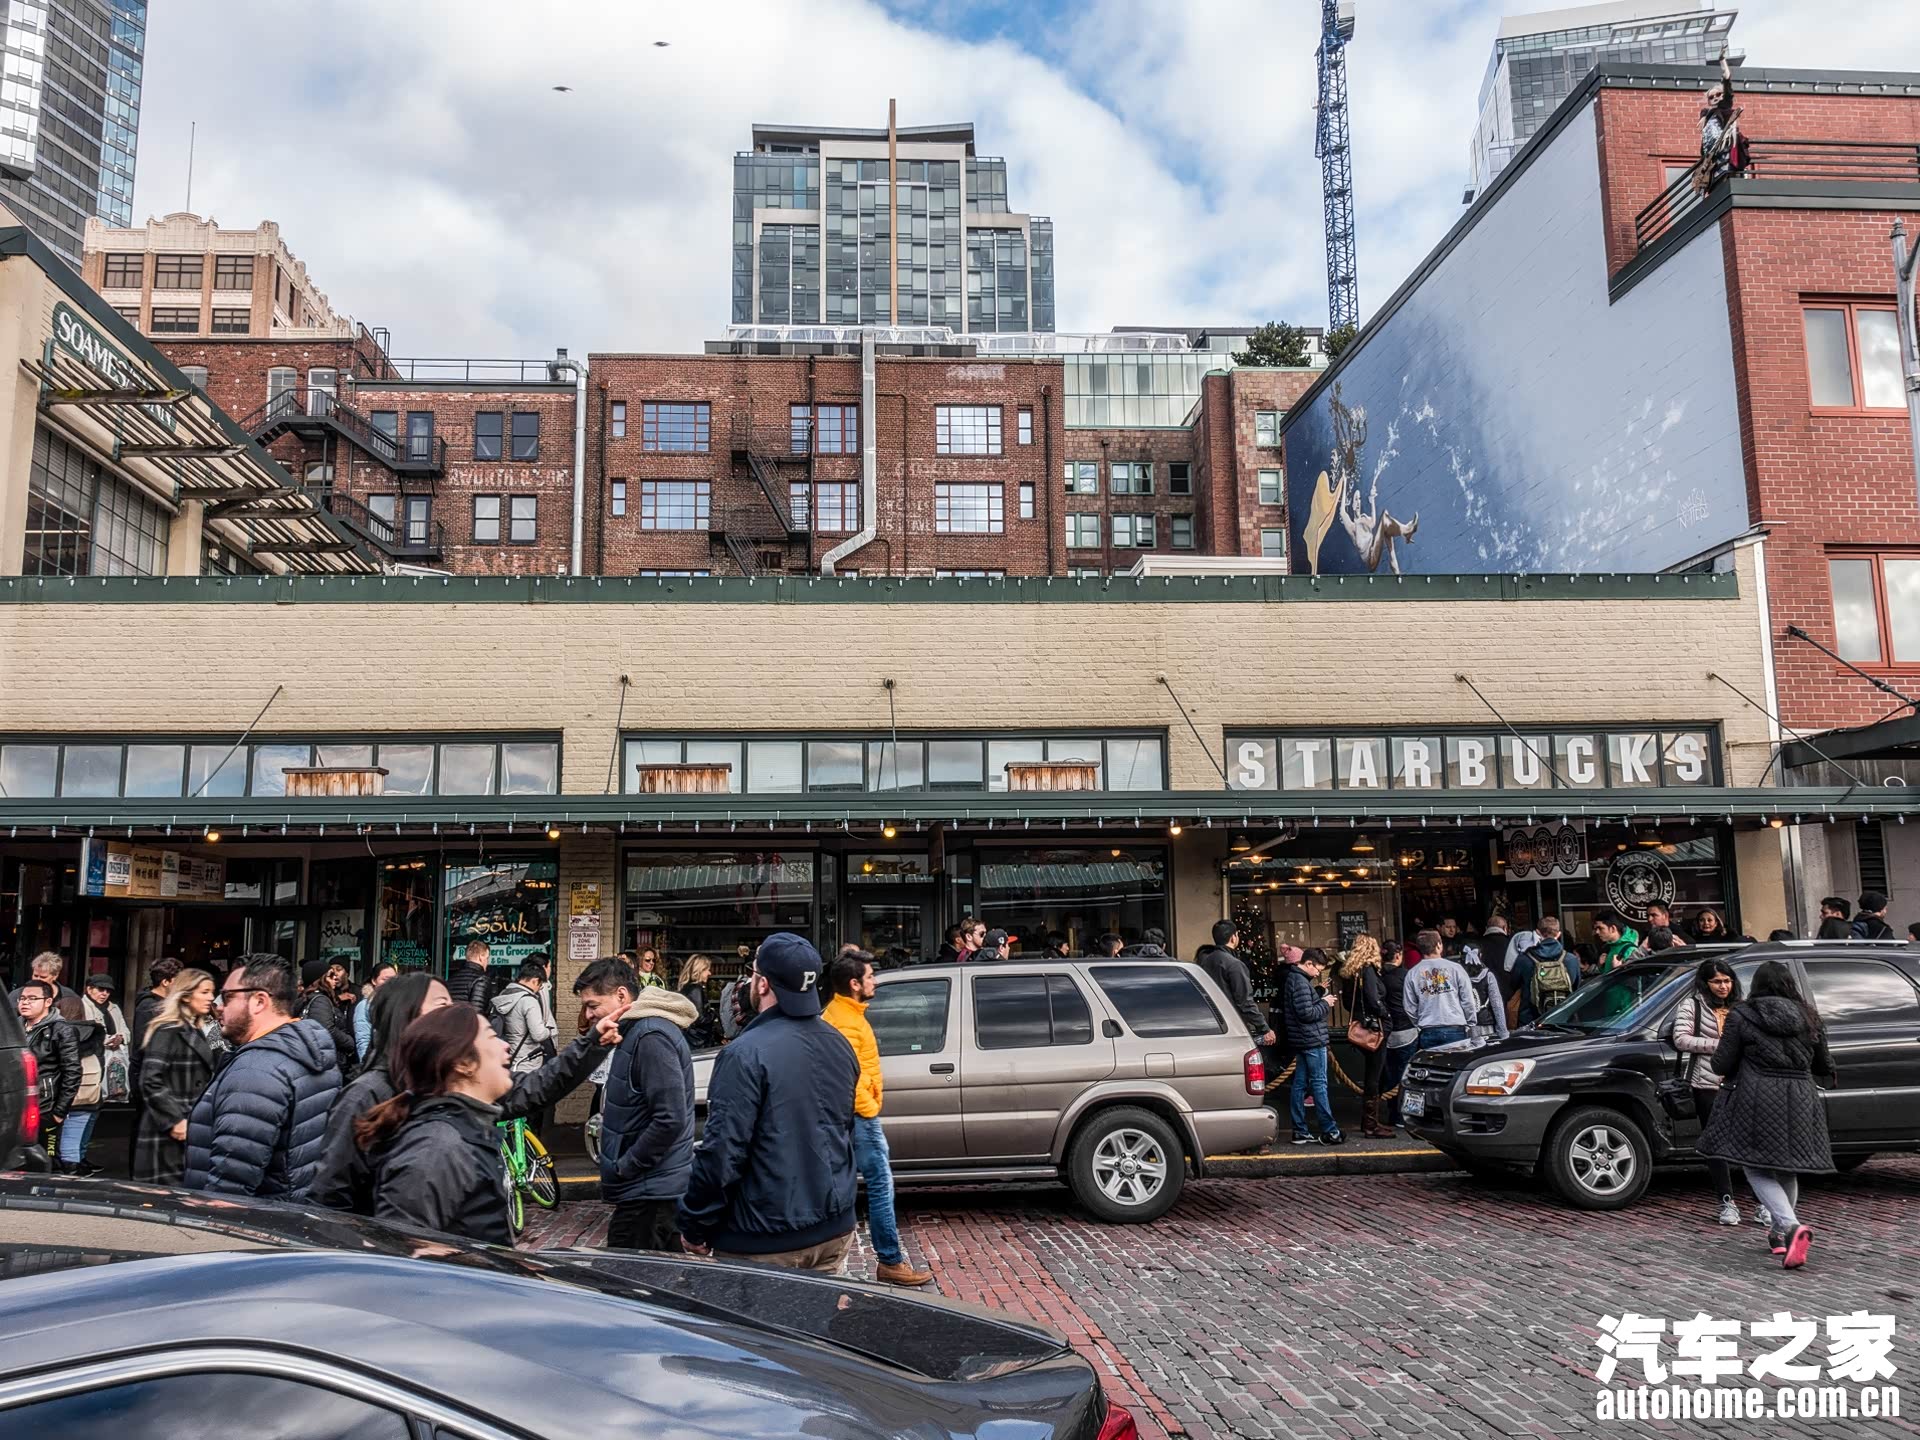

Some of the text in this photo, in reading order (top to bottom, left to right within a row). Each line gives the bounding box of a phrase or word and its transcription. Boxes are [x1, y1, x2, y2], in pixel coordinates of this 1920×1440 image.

[1238, 736, 1703, 789] STARBUCKS
[1616, 852, 1661, 870] STARBUCKS
[1608, 881, 1628, 911] COFFEE
[1661, 880, 1672, 904] PICES
[466, 912, 538, 935] Souk
[1637, 910, 1648, 919] TE
[391, 939, 417, 949] INDIAN
[800, 971, 817, 992] P
[47, 1134, 57, 1156] NIKE
